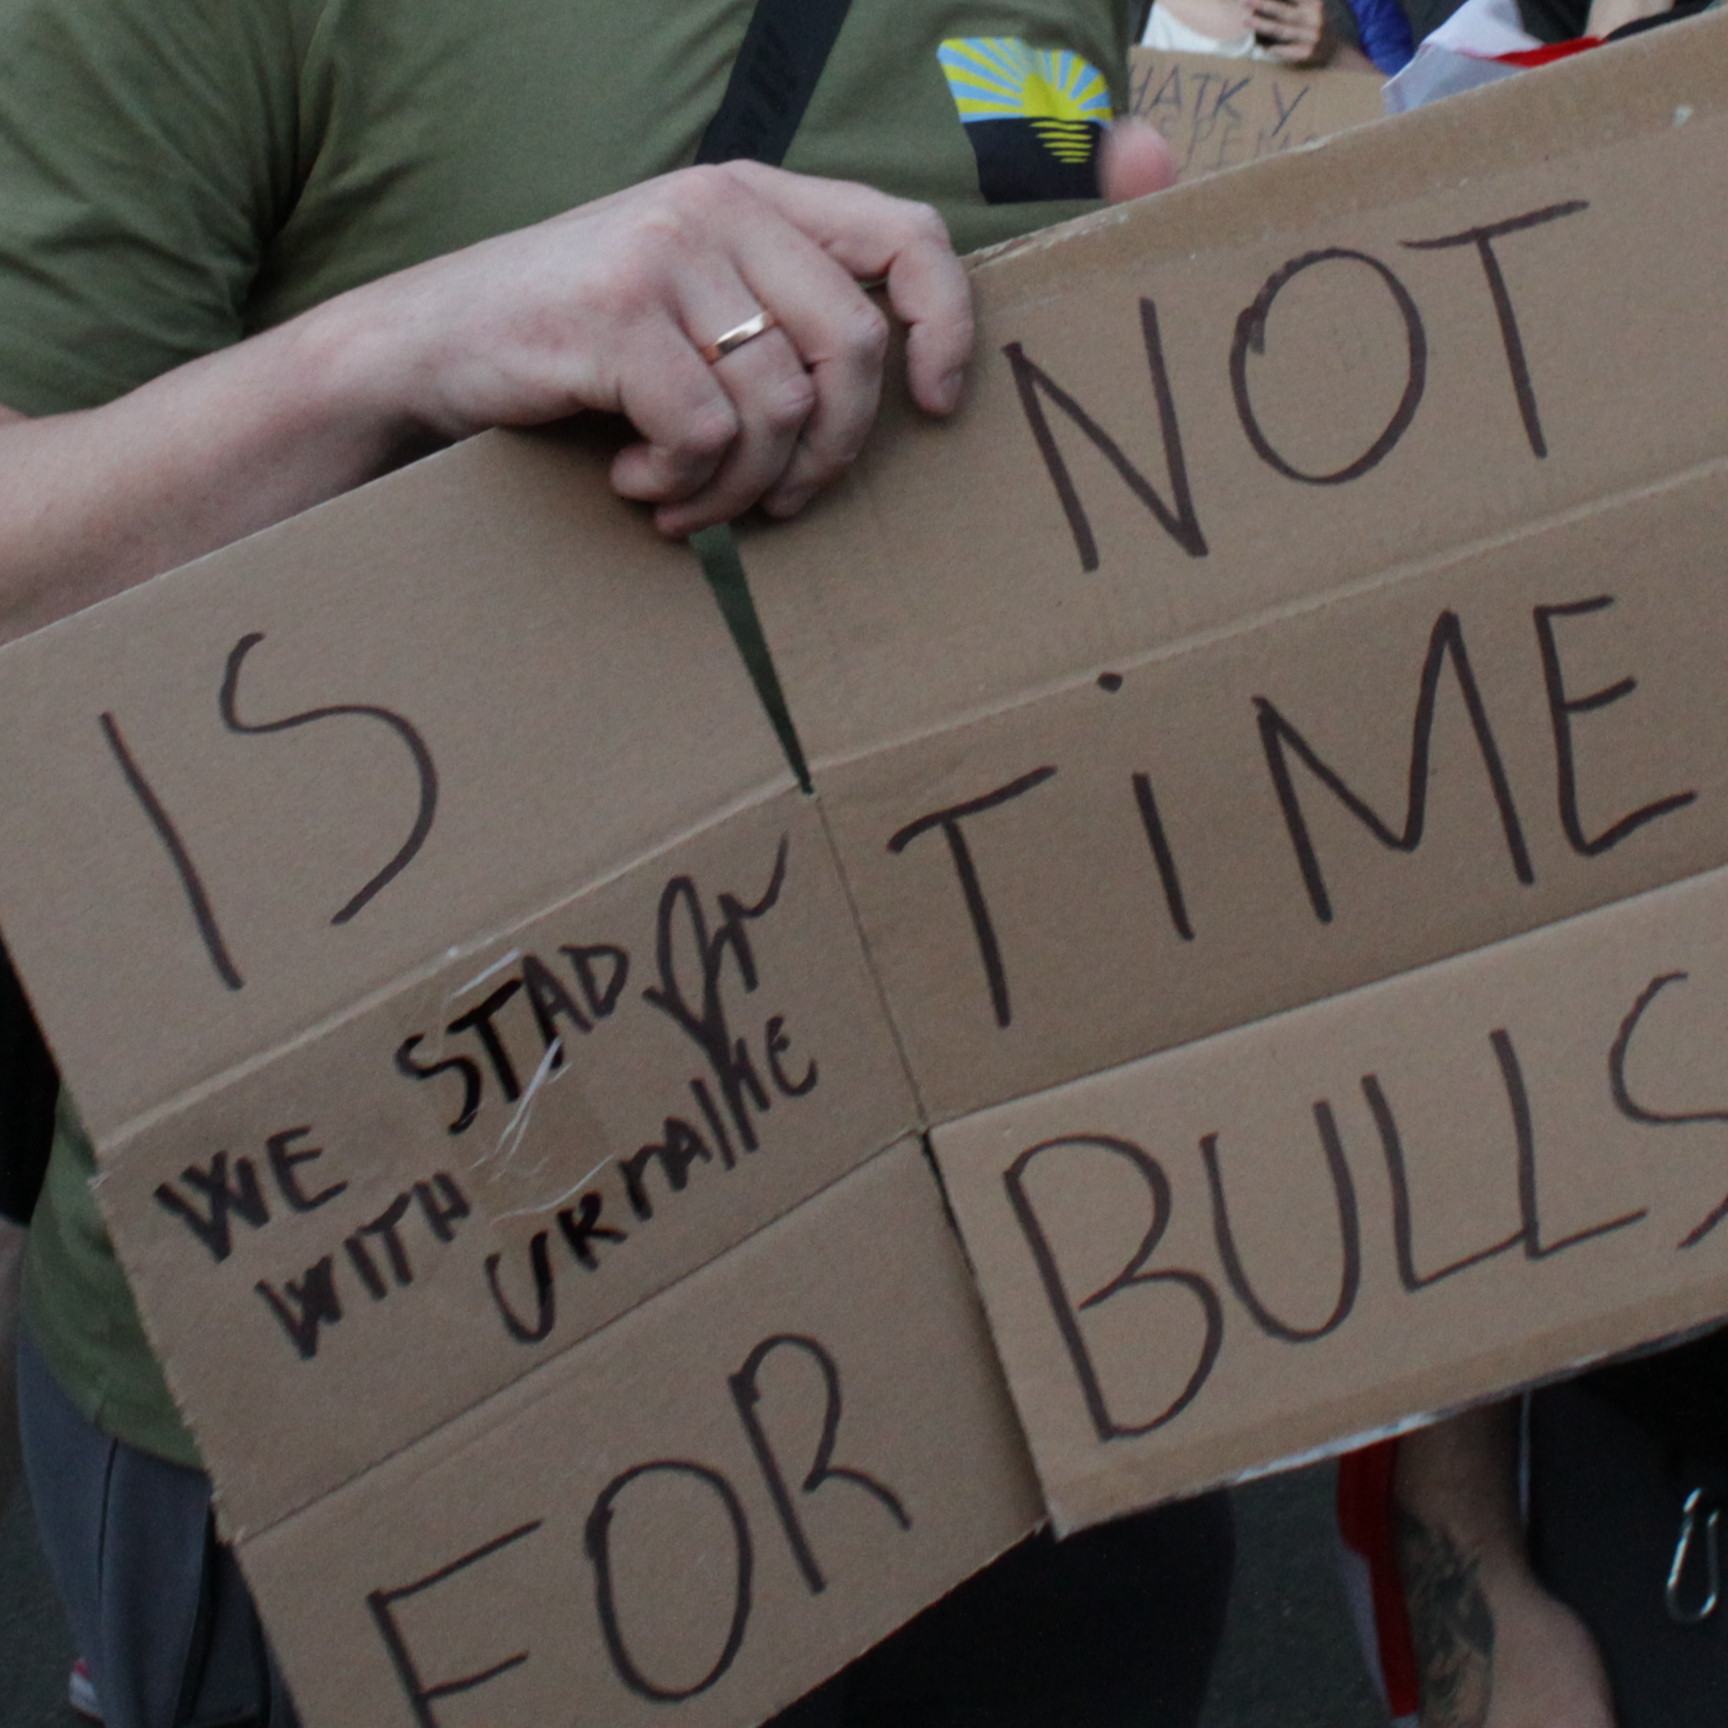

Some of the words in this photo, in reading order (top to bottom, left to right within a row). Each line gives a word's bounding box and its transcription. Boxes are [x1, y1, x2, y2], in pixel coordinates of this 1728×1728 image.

[98, 629, 442, 993] IS
[1001, 198, 1592, 576] NOT
[154, 1125, 352, 1265] WE
[393, 942, 631, 1136] STAD
[254, 1171, 473, 1360] WITH
[367, 1332, 914, 1728] FOR
